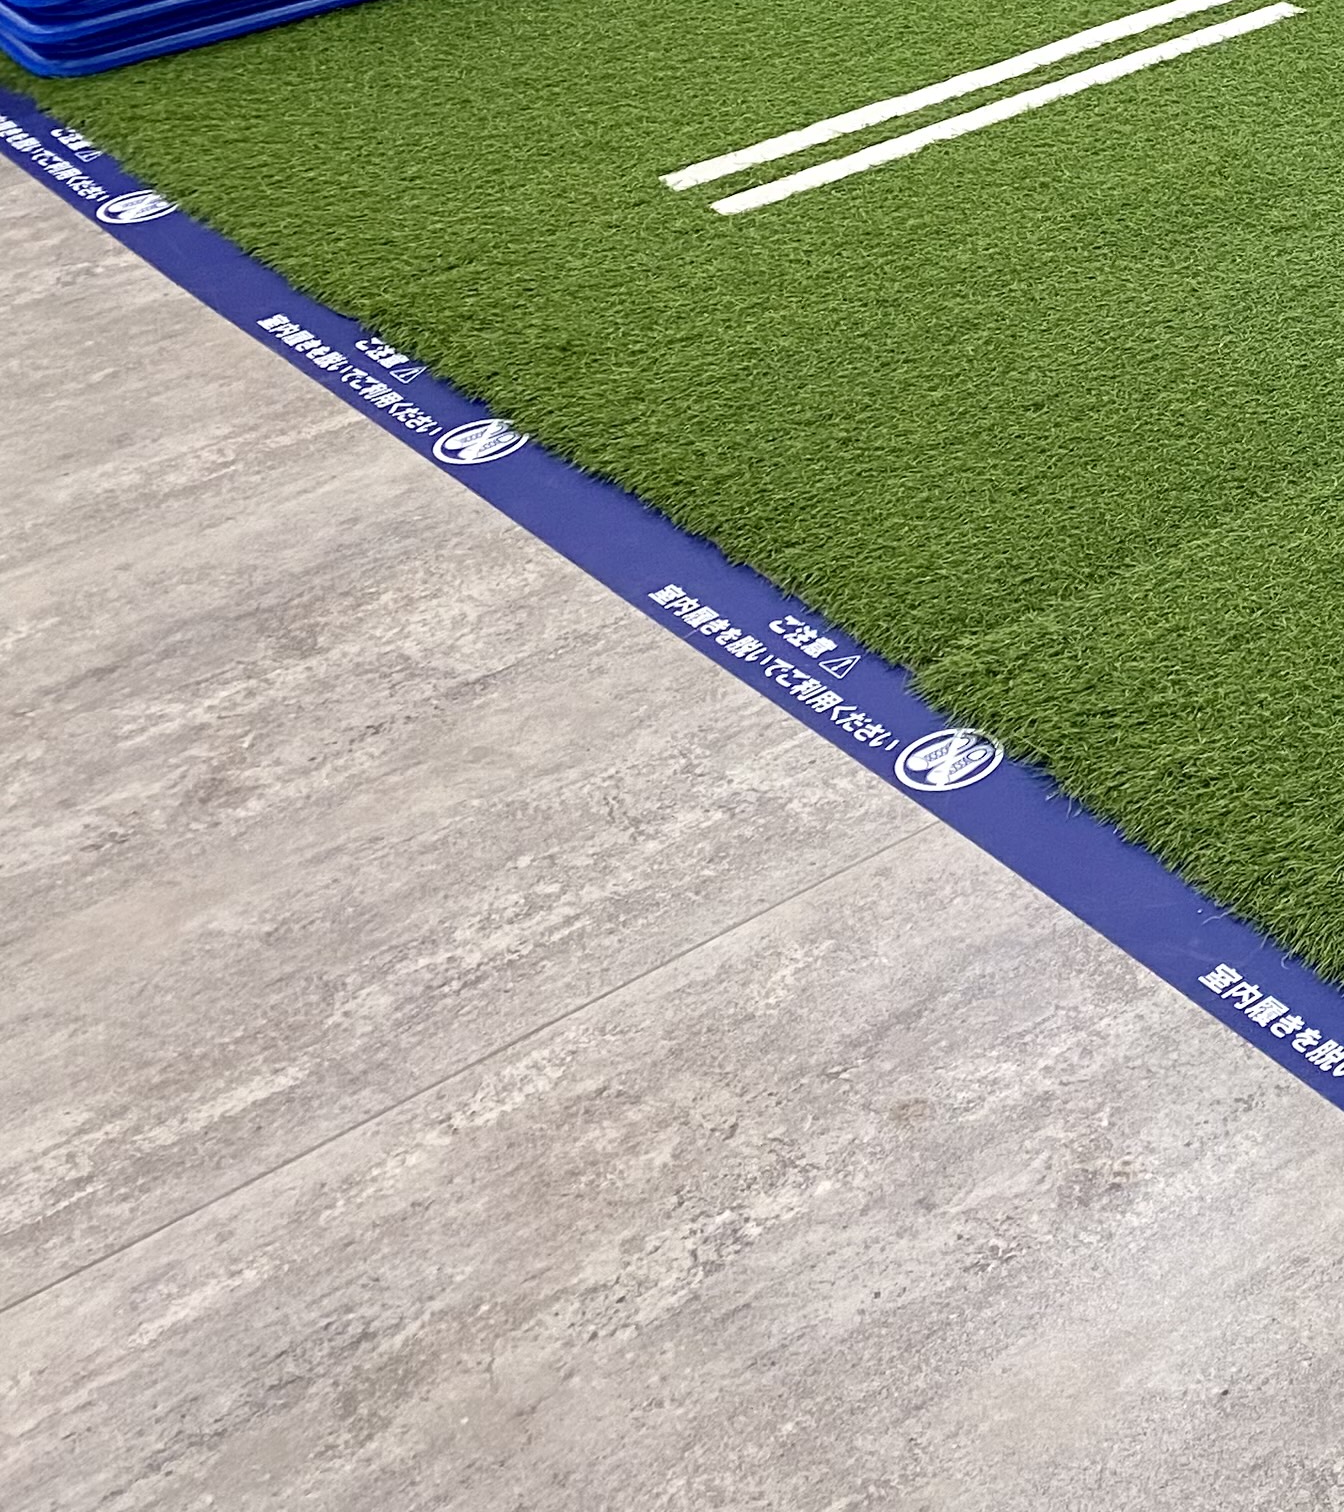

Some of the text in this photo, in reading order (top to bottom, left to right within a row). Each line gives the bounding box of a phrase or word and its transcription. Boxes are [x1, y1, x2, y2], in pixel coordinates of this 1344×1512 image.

[648, 583, 900, 751] 室内履きを脱いでご利用ください
[769, 615, 838, 658] ご注意
